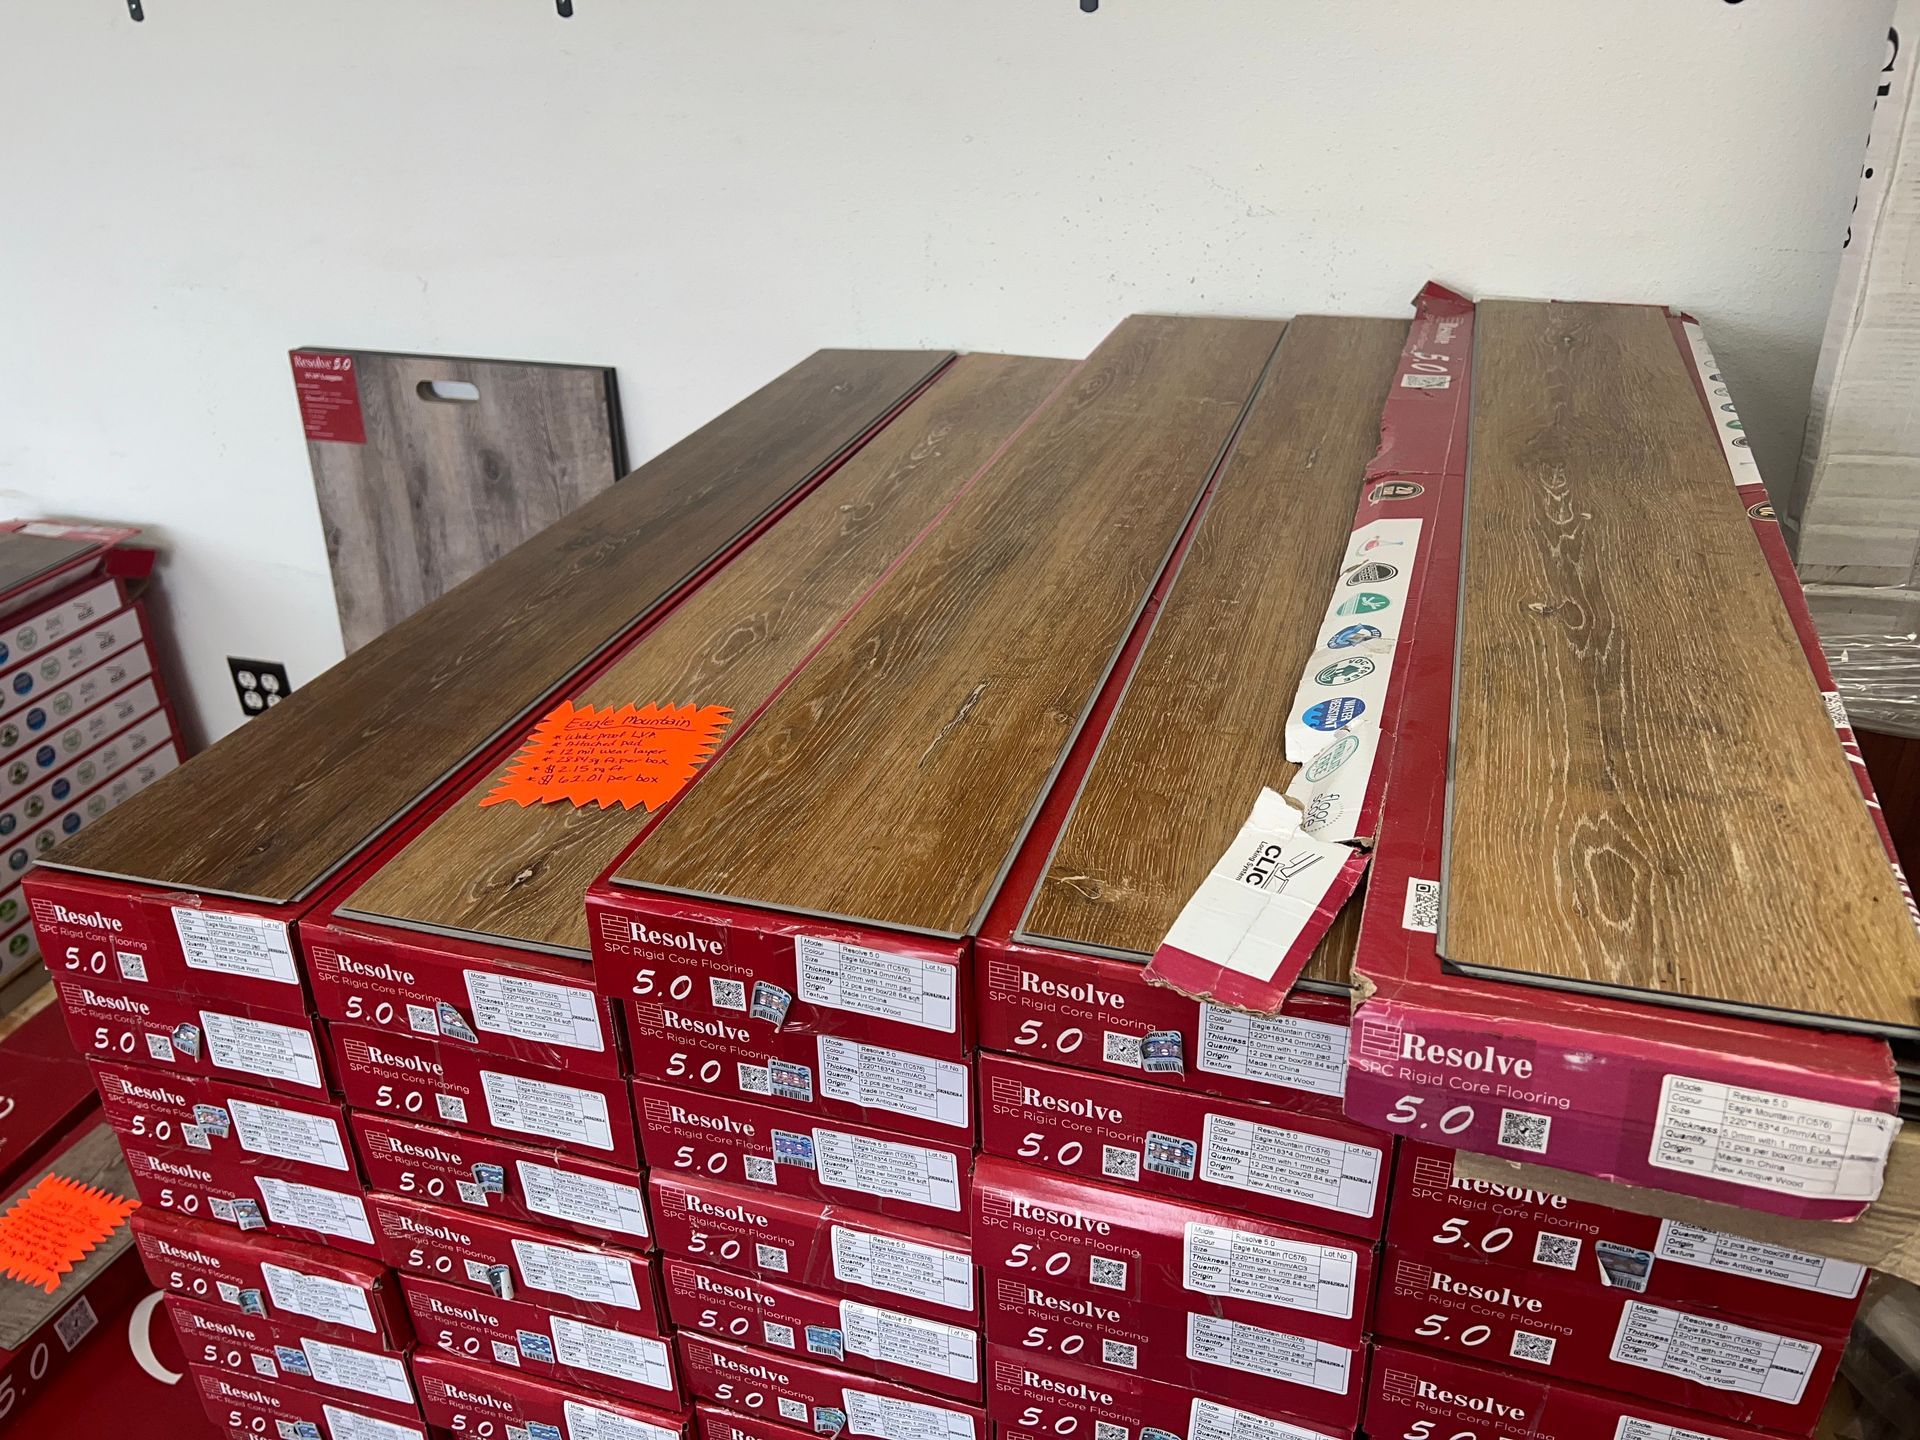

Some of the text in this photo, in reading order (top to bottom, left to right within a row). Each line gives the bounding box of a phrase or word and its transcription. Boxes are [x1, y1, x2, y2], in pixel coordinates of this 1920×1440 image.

[566, 716, 691, 729] Eagle Mountain
[1325, 698, 1342, 729] RESISTANT
[1341, 700, 1356, 721] WATER
[645, 757, 670, 765] box
[636, 774, 659, 783] box
[1316, 794, 1340, 824] floor
[1236, 841, 1268, 881] Locking System
[1246, 845, 1281, 885] CLIC
[53, 905, 122, 932] Resolve
[39, 924, 147, 951] SPC Rigid Core Flooring
[629, 922, 723, 955] Resolve
[65, 946, 106, 973] 5.0
[336, 954, 415, 985] Resolve
[604, 942, 753, 977] SPC Rigid Core Flooring
[632, 969, 692, 1000] 5.0
[1021, 971, 1124, 1009] Resolve
[81, 989, 150, 1015] Resolve
[345, 996, 393, 1024] 5.0
[663, 1009, 750, 1043] Resolve
[1014, 1019, 1083, 1053] 5.0
[95, 1027, 135, 1053] 5.0
[367, 1046, 444, 1075] Resolve
[666, 1052, 721, 1082] 5.0
[1401, 1033, 1533, 1079] Resolve
[350, 1063, 470, 1094] SPC Rigid Core Flooring
[1360, 1059, 1570, 1110] SPC Rigid Core Flooring
[120, 1079, 186, 1106] Resolve
[376, 1085, 422, 1112] 5.0
[1023, 1086, 1122, 1124] Resolve
[131, 1115, 171, 1140] 5.0
[670, 1106, 755, 1136] Resolve
[1387, 1095, 1474, 1135] 5.0
[1157, 1135, 1180, 1144] UNILIN
[1212, 1133, 1228, 1142] Size
[1213, 1126, 1235, 1135] Colour
[1254, 1134, 1273, 1145] Eagle
[1273, 1138, 1303, 1150] Mountain
[1257, 1126, 1285, 1137] Resolve
[388, 1137, 462, 1165] Resolve
[674, 1146, 727, 1173] 5.0
[1017, 1132, 1083, 1165] 5.0
[1209, 1151, 1242, 1164] Quantity
[1211, 1142, 1249, 1156] Thickness
[147, 1156, 212, 1182] Resolve
[1208, 1160, 1232, 1172] Origin
[1209, 1169, 1234, 1180] Texture
[1249, 1169, 1269, 1179] Made
[1279, 1176, 1300, 1186] China
[1261, 1163, 1274, 1172] pcs
[1274, 1166, 1287, 1175] per
[1277, 1158, 1292, 1166] with
[1315, 1167, 1329, 1176] pad
[399, 1172, 444, 1196] 5.0
[1248, 1178, 1314, 1199] New Antique Wood
[160, 1189, 198, 1212] 5.0
[685, 1195, 768, 1227] Resolve
[1013, 1198, 1110, 1235] Resolve
[399, 1216, 471, 1245] Resolve
[1432, 1218, 1513, 1253] 5.0
[157, 1240, 220, 1268] Resolve
[687, 1232, 740, 1259] 5.0
[1005, 1243, 1071, 1275] 5.0
[1609, 1244, 1634, 1253] UNILIN
[408, 1249, 452, 1273] 5.0
[170, 1271, 207, 1294] 5.0
[695, 1275, 775, 1307] Resolve
[1430, 1272, 1542, 1312] Resolve
[429, 1298, 498, 1327] Resolve
[1027, 1288, 1120, 1322] Resolve
[192, 1315, 255, 1341] Resolve
[698, 1309, 749, 1335] 5.0
[999, 1302, 1149, 1343] SPC Rigid Core Flooring
[1414, 1314, 1491, 1346] 5.0
[437, 1330, 480, 1354] 5.0
[1022, 1326, 1084, 1354] 5.0
[204, 1345, 241, 1367] 5.0
[712, 1353, 789, 1385] Resolve
[218, 1382, 280, 1407] Resolve
[444, 1383, 513, 1412] Resolve
[714, 1383, 763, 1407] 5.0
[1023, 1370, 1113, 1405] Resolve
[1417, 1380, 1525, 1421] Resolve
[229, 1411, 266, 1432] 5.0
[451, 1414, 493, 1437] 5.0
[1018, 1407, 1078, 1434] 5.0
[1403, 1420, 1477, 1440] 5.0
